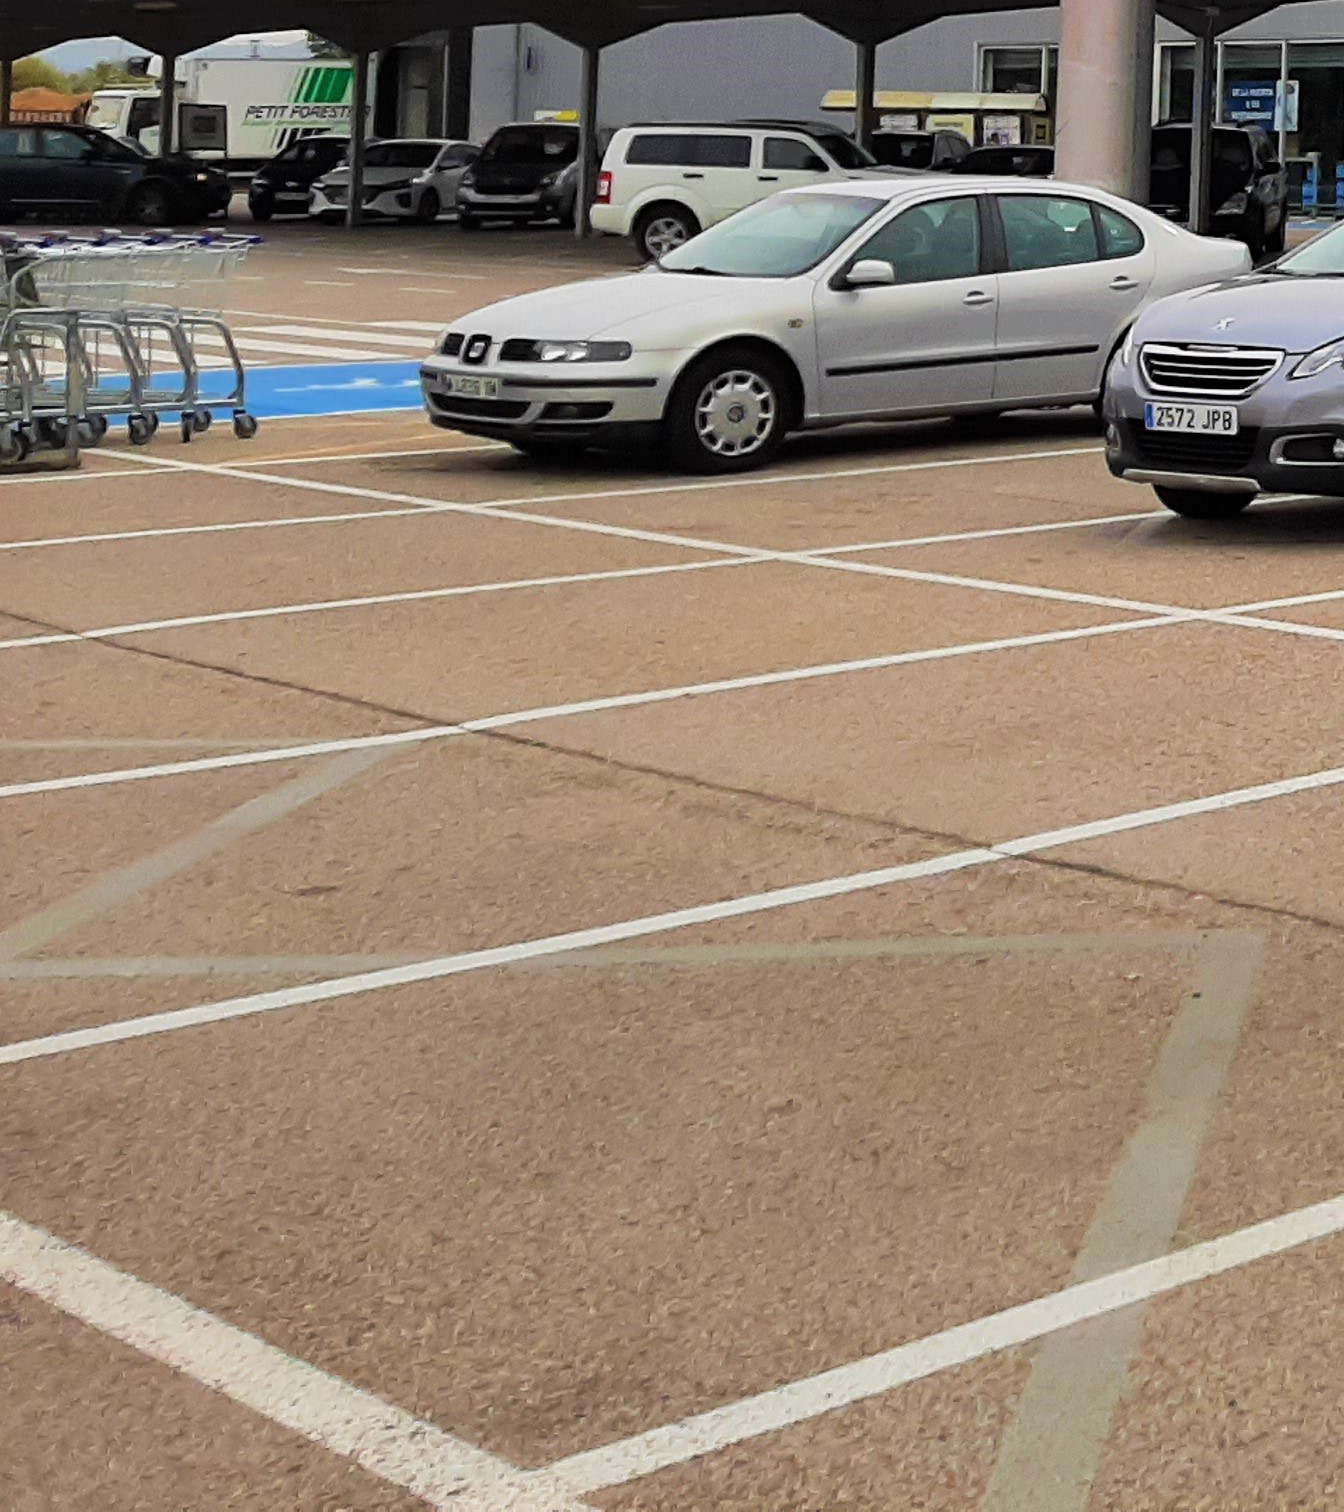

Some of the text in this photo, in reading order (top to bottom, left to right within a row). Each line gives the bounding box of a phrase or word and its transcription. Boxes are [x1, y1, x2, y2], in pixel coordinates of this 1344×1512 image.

[245, 105, 289, 120] PETIT
[1155, 406, 1233, 431] 2572 JPB
